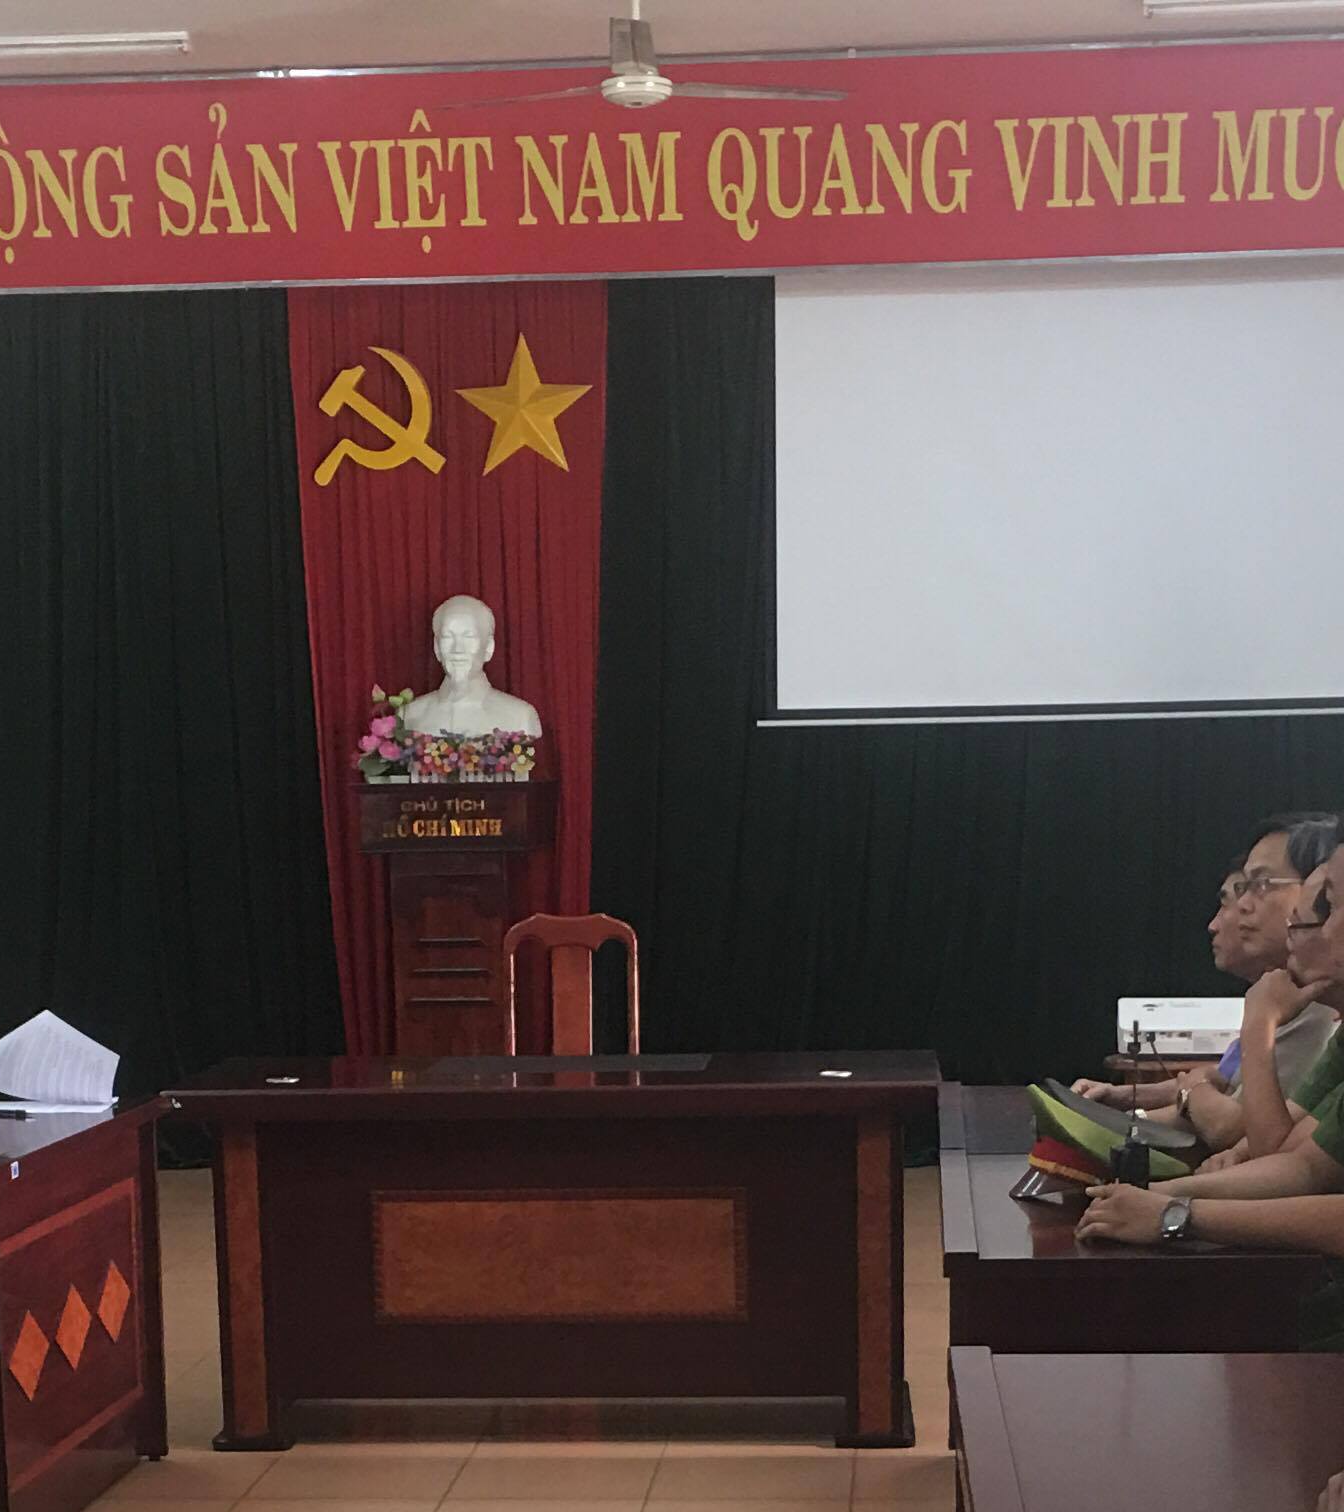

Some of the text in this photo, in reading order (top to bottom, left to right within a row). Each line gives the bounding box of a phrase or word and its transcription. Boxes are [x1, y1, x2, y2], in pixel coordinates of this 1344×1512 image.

[156, 103, 298, 238] SẢN
[318, 109, 494, 253] VIỆT
[515, 130, 684, 226] NAM
[707, 117, 972, 242] QUANG
[994, 112, 1189, 211] VINH
[449, 818, 503, 838] MINH
